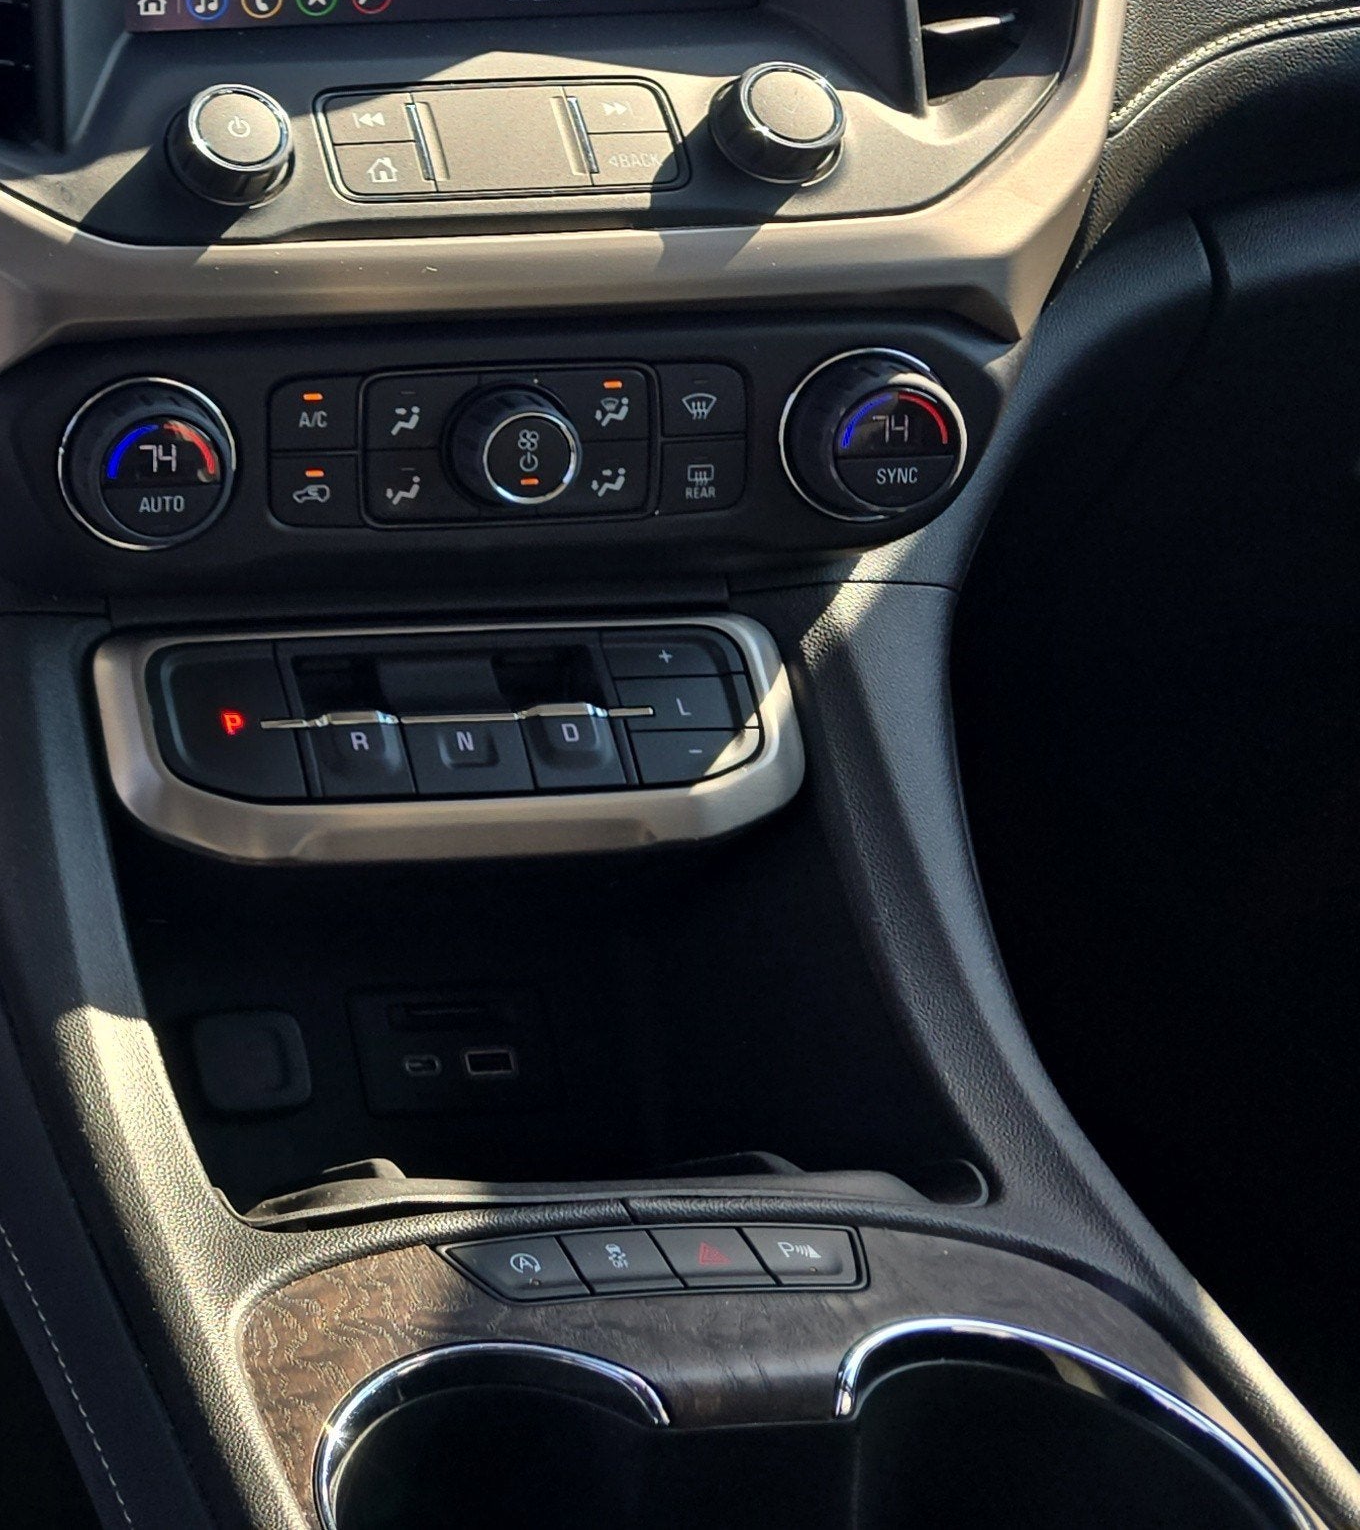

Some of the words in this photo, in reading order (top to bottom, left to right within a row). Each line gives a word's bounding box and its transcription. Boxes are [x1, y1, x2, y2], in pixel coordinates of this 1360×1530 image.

[619, 152, 663, 168] BACK
[298, 411, 327, 428] A/C
[872, 414, 909, 443] 74
[139, 444, 177, 472] 74
[875, 467, 918, 485] SYNC
[685, 486, 716, 500] REAR
[138, 495, 186, 513] AUTO
[677, 698, 691, 717] L
[222, 712, 244, 736] P
[562, 723, 580, 743] D
[351, 732, 369, 751] R
[457, 731, 474, 751] N
